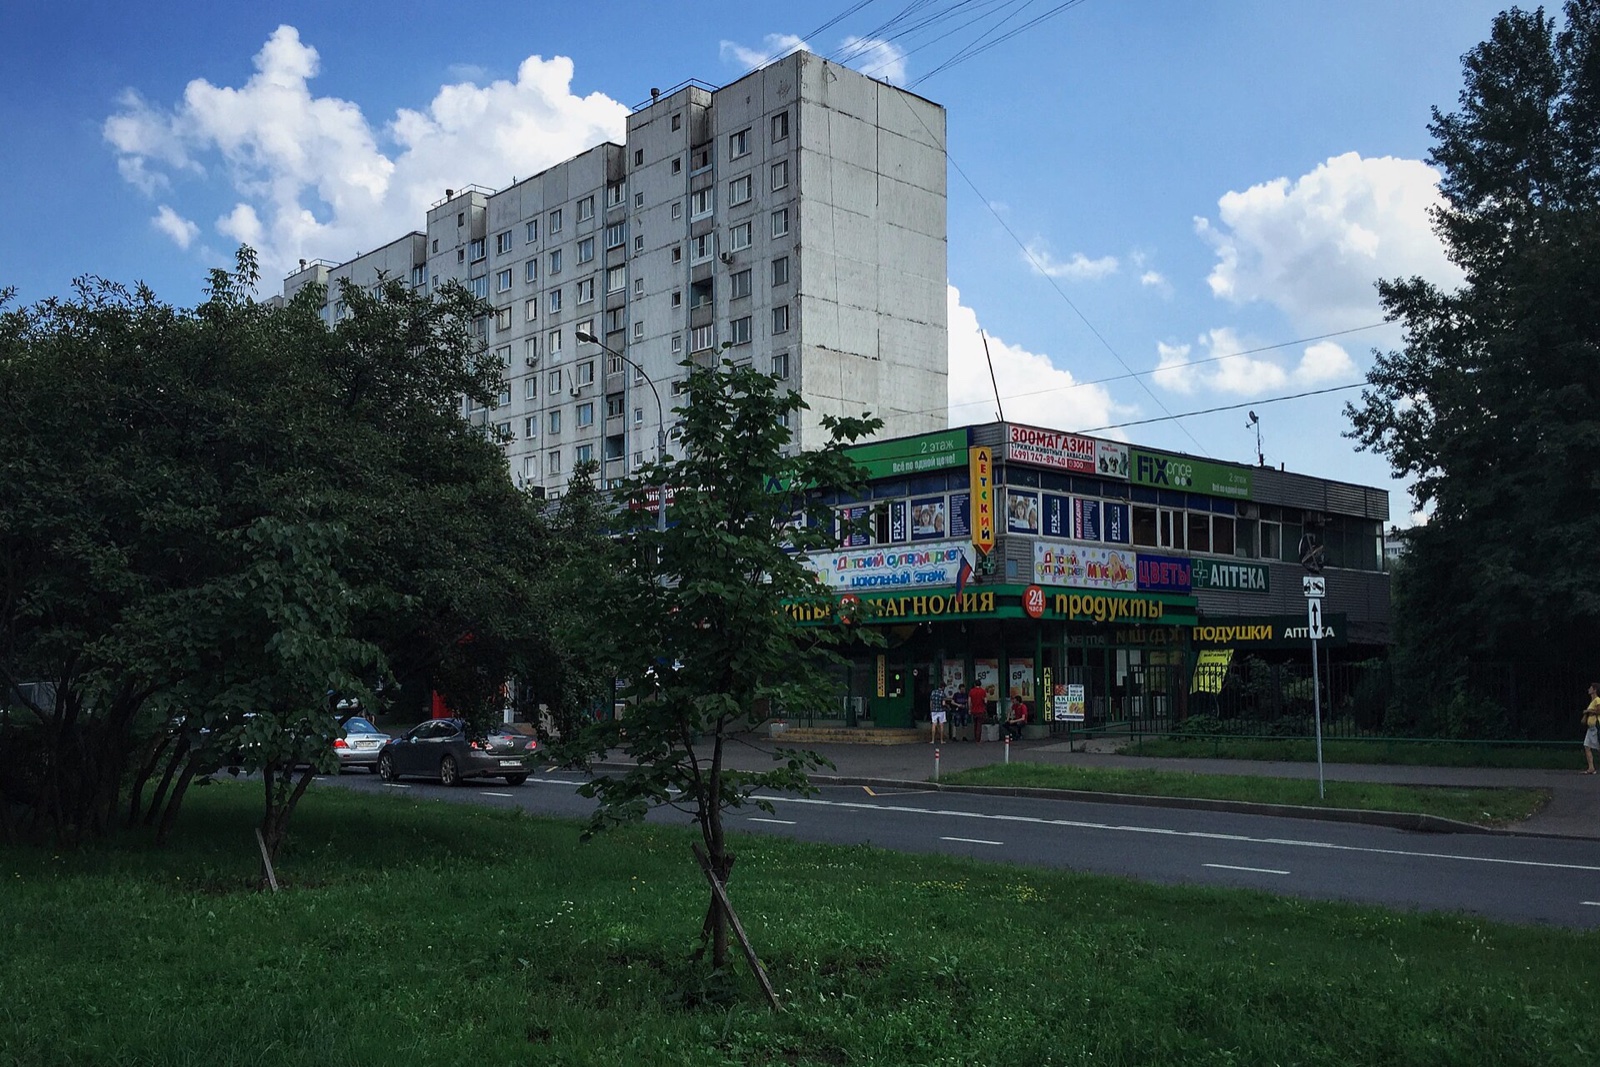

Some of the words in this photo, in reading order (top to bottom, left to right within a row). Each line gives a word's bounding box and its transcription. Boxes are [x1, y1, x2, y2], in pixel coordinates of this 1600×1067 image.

[921, 441, 927, 454] 2
[929, 440, 954, 453] этаж
[1011, 443, 1034, 452] СТРИЖКА
[1035, 446, 1063, 457] ЖИВОТНЫХ
[1012, 428, 1093, 455] ЗООМАГАЗИН
[892, 460, 905, 473] Всё
[905, 461, 914, 471] по
[914, 456, 936, 470] одной
[936, 453, 956, 467] цене!
[1011, 449, 1029, 460] (499)
[1030, 452, 1066, 466] 747-89-40
[1166, 461, 1192, 477] price
[978, 450, 990, 540] ДЕТСКИЙ
[837, 552, 884, 571] Детский
[1139, 560, 1190, 587] ЦВЕТЫ
[1210, 563, 1265, 590] АПТЕКА
[1029, 589, 1043, 605] 24
[1029, 604, 1043, 613] часа
[1055, 594, 1163, 622] продукты
[1193, 625, 1273, 645] ПОДУШКИ
[1284, 627, 1336, 639] АПТА
